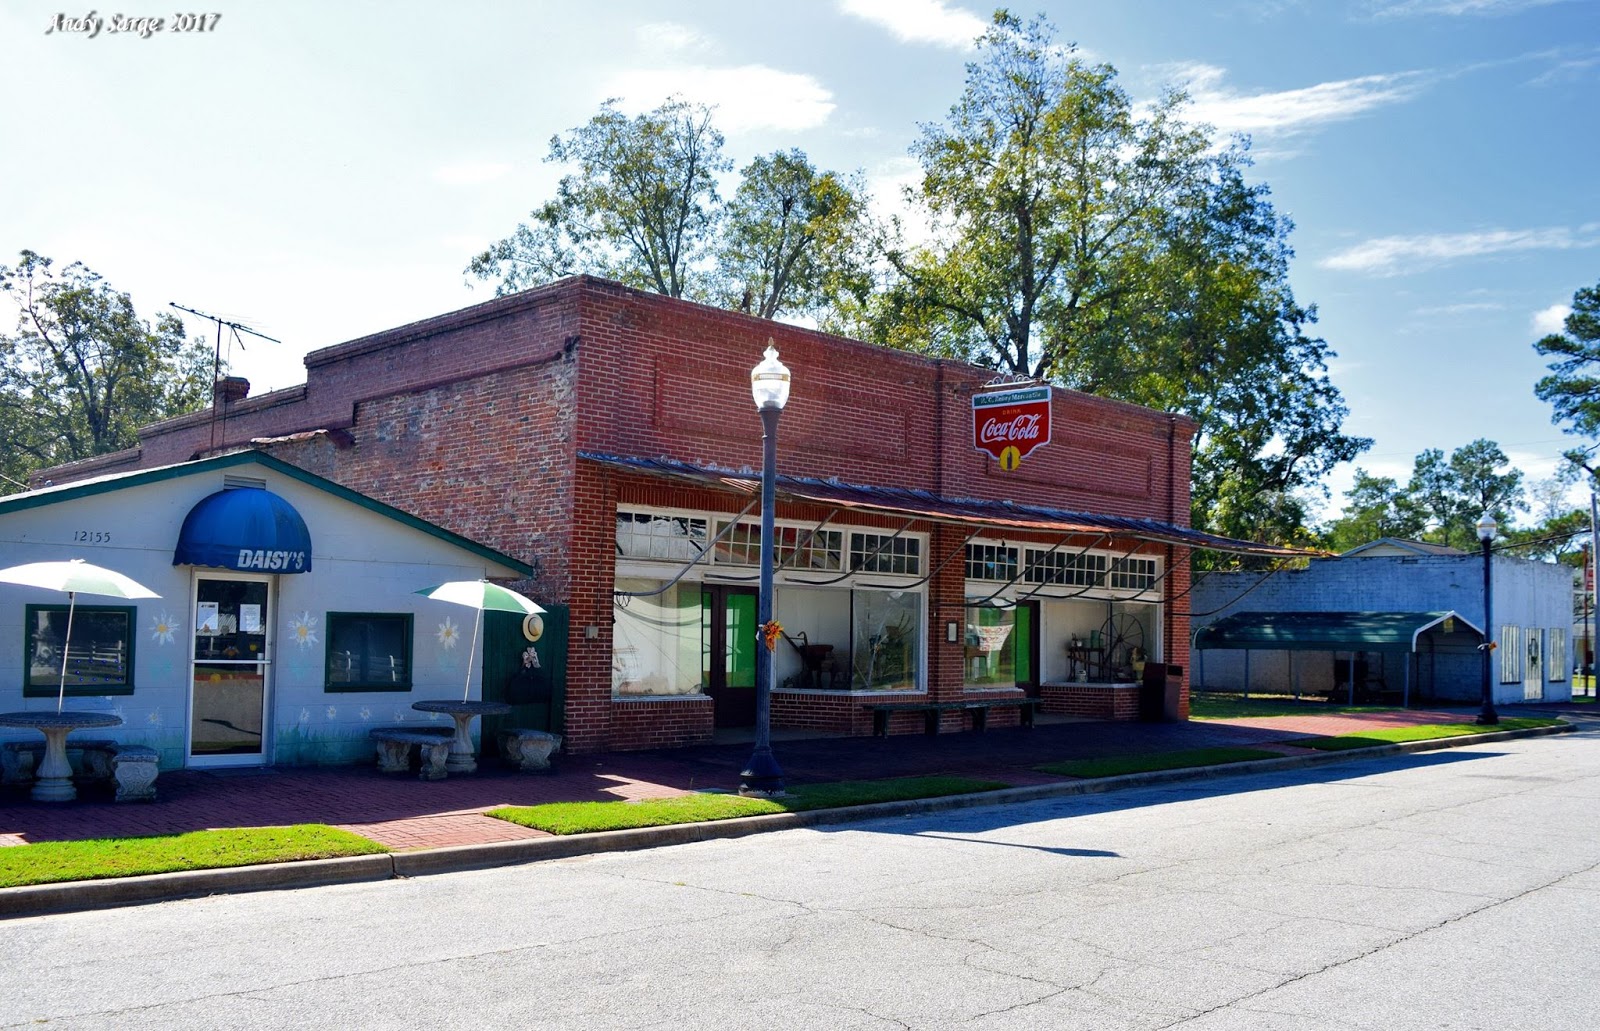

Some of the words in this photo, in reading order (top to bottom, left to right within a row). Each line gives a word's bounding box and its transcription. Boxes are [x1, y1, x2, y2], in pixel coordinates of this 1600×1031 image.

[980, 413, 1042, 443] Coca-Cola
[74, 530, 111, 543] 12155
[237, 549, 305, 570] DAISY'S
